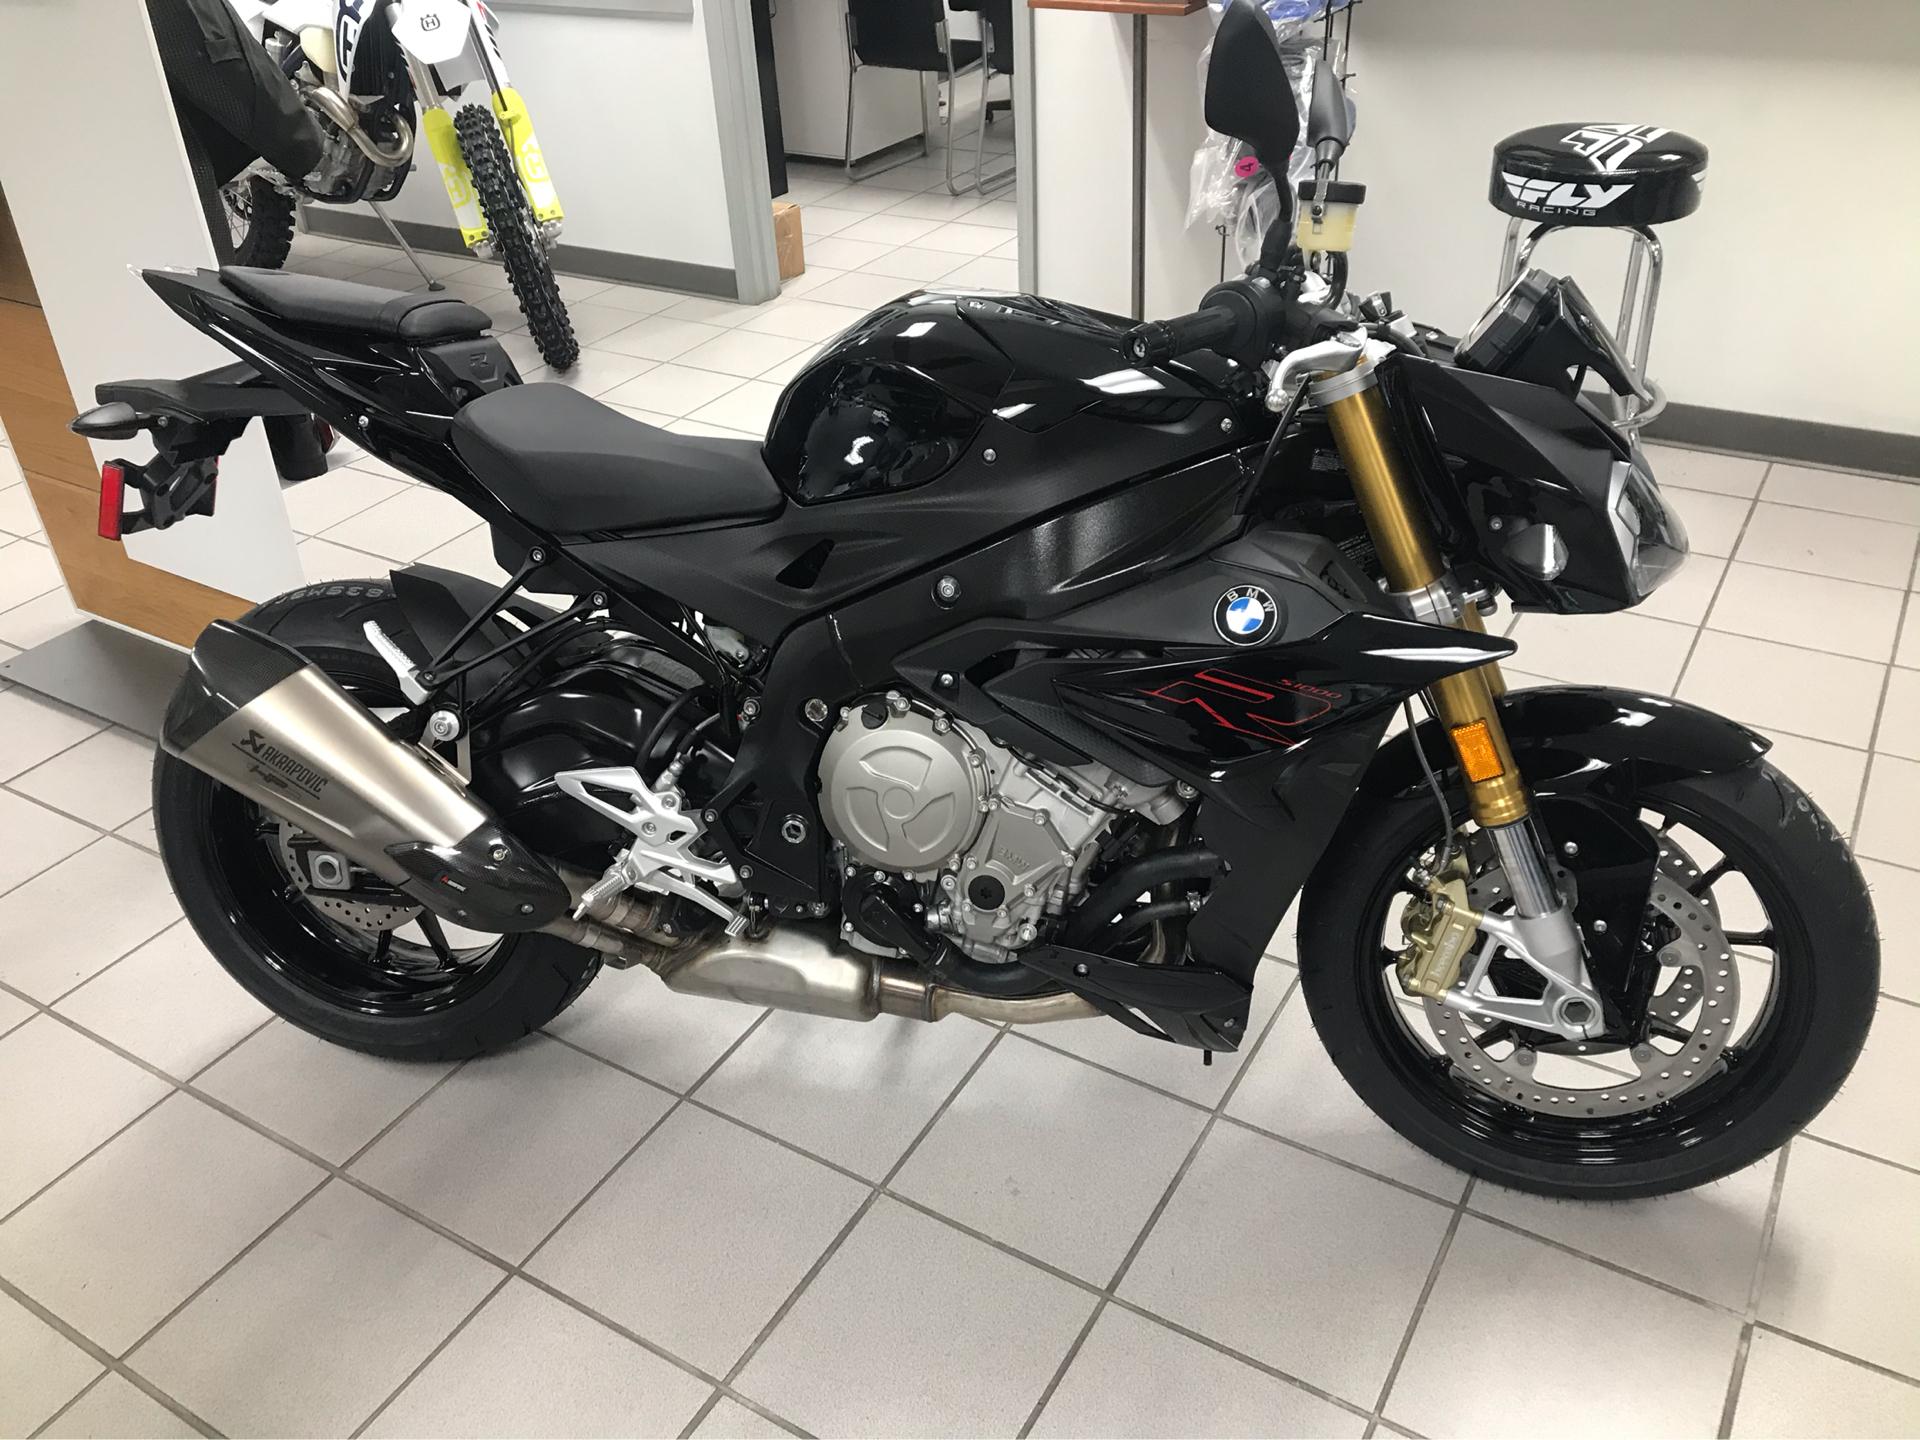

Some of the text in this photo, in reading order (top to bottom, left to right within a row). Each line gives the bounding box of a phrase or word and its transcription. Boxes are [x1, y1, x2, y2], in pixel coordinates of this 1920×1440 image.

[1502, 171, 1635, 208] FLY
[1516, 200, 1597, 217] RACING
[1226, 587, 1275, 613] BMW
